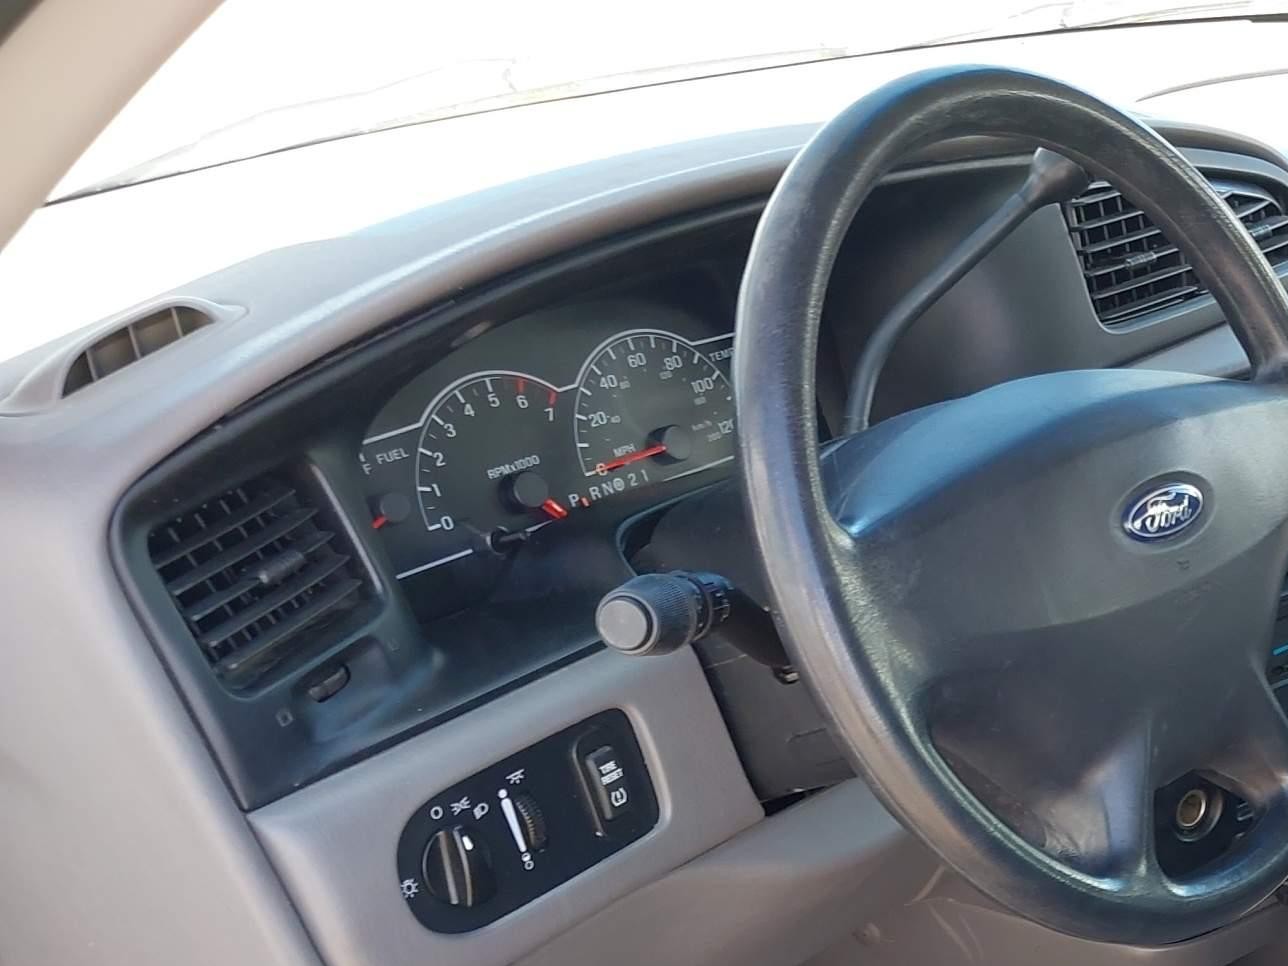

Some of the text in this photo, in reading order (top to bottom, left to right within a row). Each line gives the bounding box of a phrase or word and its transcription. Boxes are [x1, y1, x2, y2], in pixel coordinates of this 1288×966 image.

[627, 352, 647, 368] 60
[663, 355, 683, 370] 80
[600, 374, 618, 389] 40
[691, 377, 714, 393] 100
[487, 393, 500, 408] 5
[516, 395, 529, 409] 6
[464, 403, 475, 417] 4
[544, 407, 554, 422] 7
[589, 411, 607, 428] 20
[443, 423, 457, 438] 3
[376, 448, 410, 464] FUEL
[613, 443, 636, 457] MPH
[432, 452, 446, 467] 2
[362, 463, 372, 475] F
[432, 484, 441, 497] 1
[568, 493, 579, 508] P
[589, 486, 602, 501] R
[601, 481, 615, 496] N
[628, 473, 638, 487] 2
[1133, 492, 1192, 533] Ford
[440, 516, 454, 530] 0
